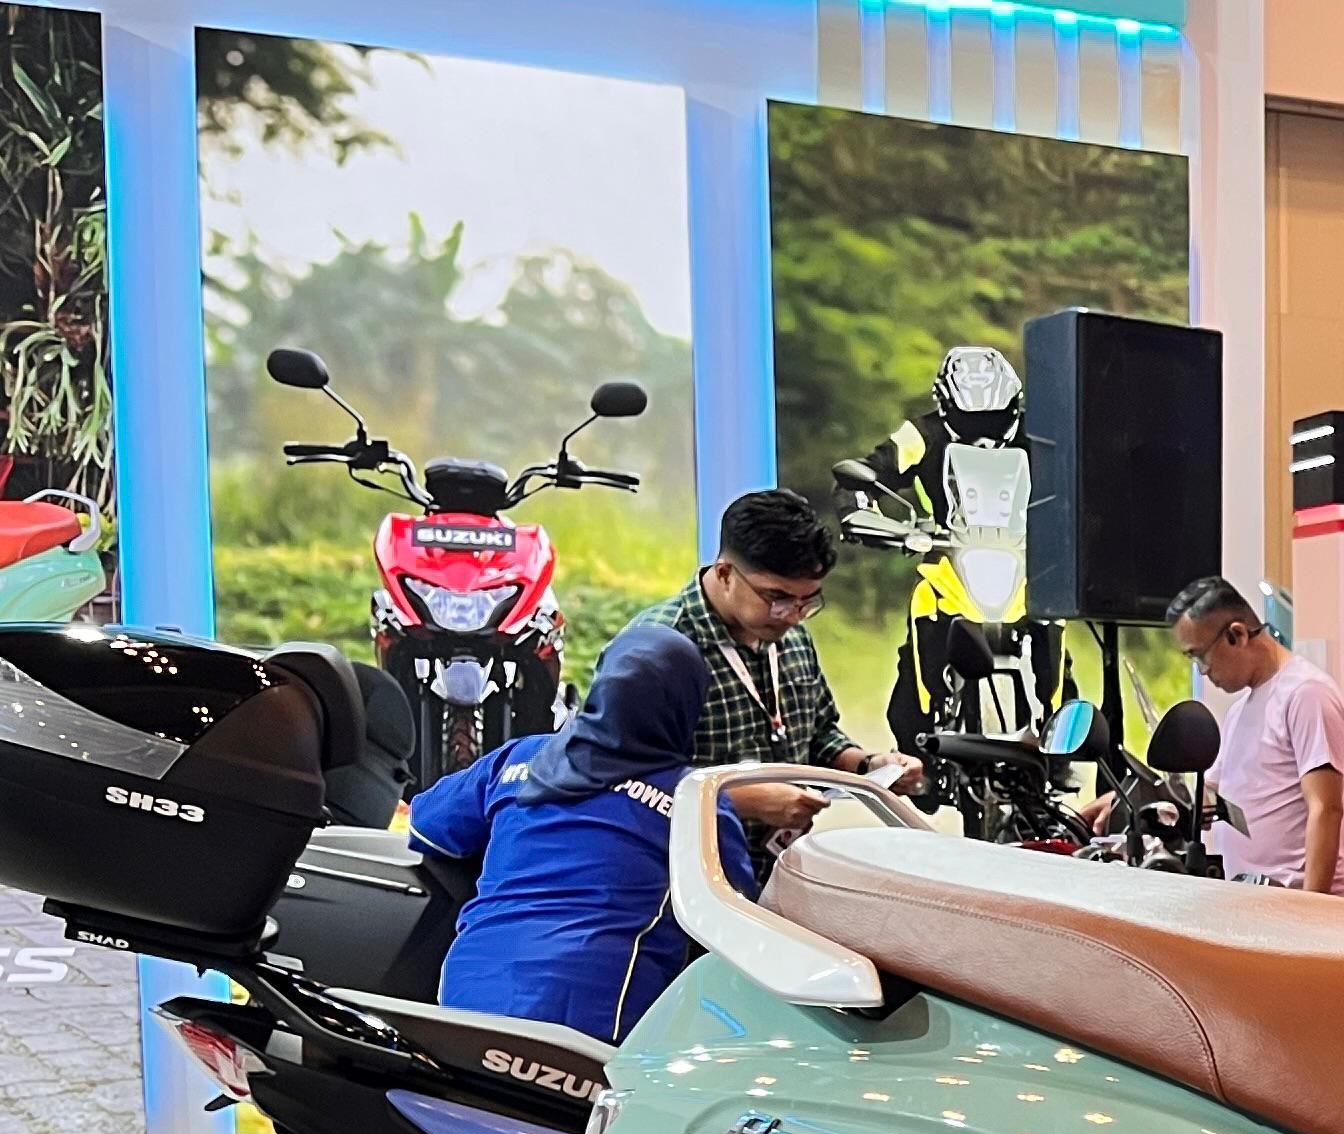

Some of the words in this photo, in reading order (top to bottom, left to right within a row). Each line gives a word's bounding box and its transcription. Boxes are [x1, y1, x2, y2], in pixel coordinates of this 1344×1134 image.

[417, 528, 513, 547] SUZUKI
[105, 786, 205, 823] SH33
[77, 931, 129, 949] SHAD
[482, 1049, 604, 1103] SUZU
